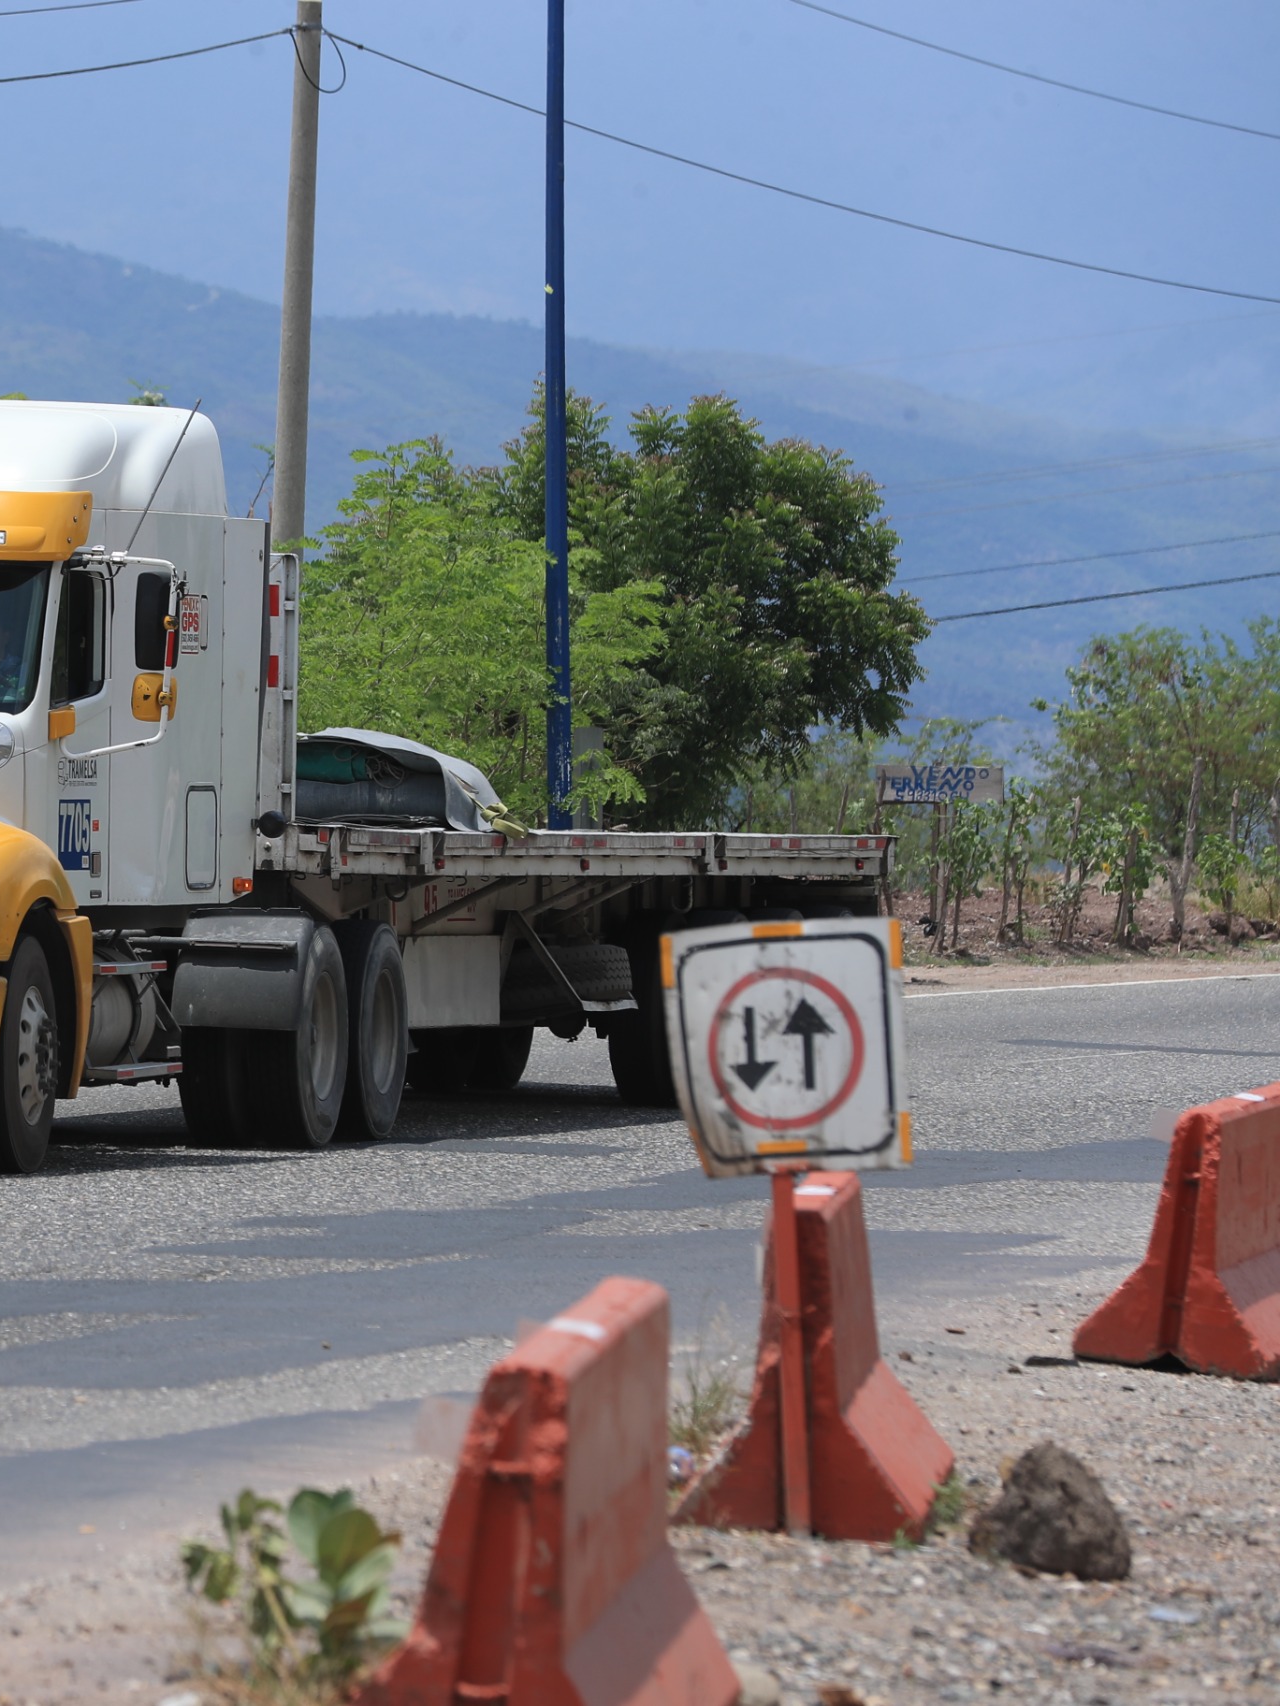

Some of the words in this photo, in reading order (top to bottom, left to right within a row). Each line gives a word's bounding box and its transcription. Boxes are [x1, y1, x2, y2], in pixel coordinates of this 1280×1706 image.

[182, 612, 199, 632] GPS
[68, 759, 97, 779] TRAMELSA
[911, 765, 989, 780] VENDO
[60, 802, 90, 853] 7705
